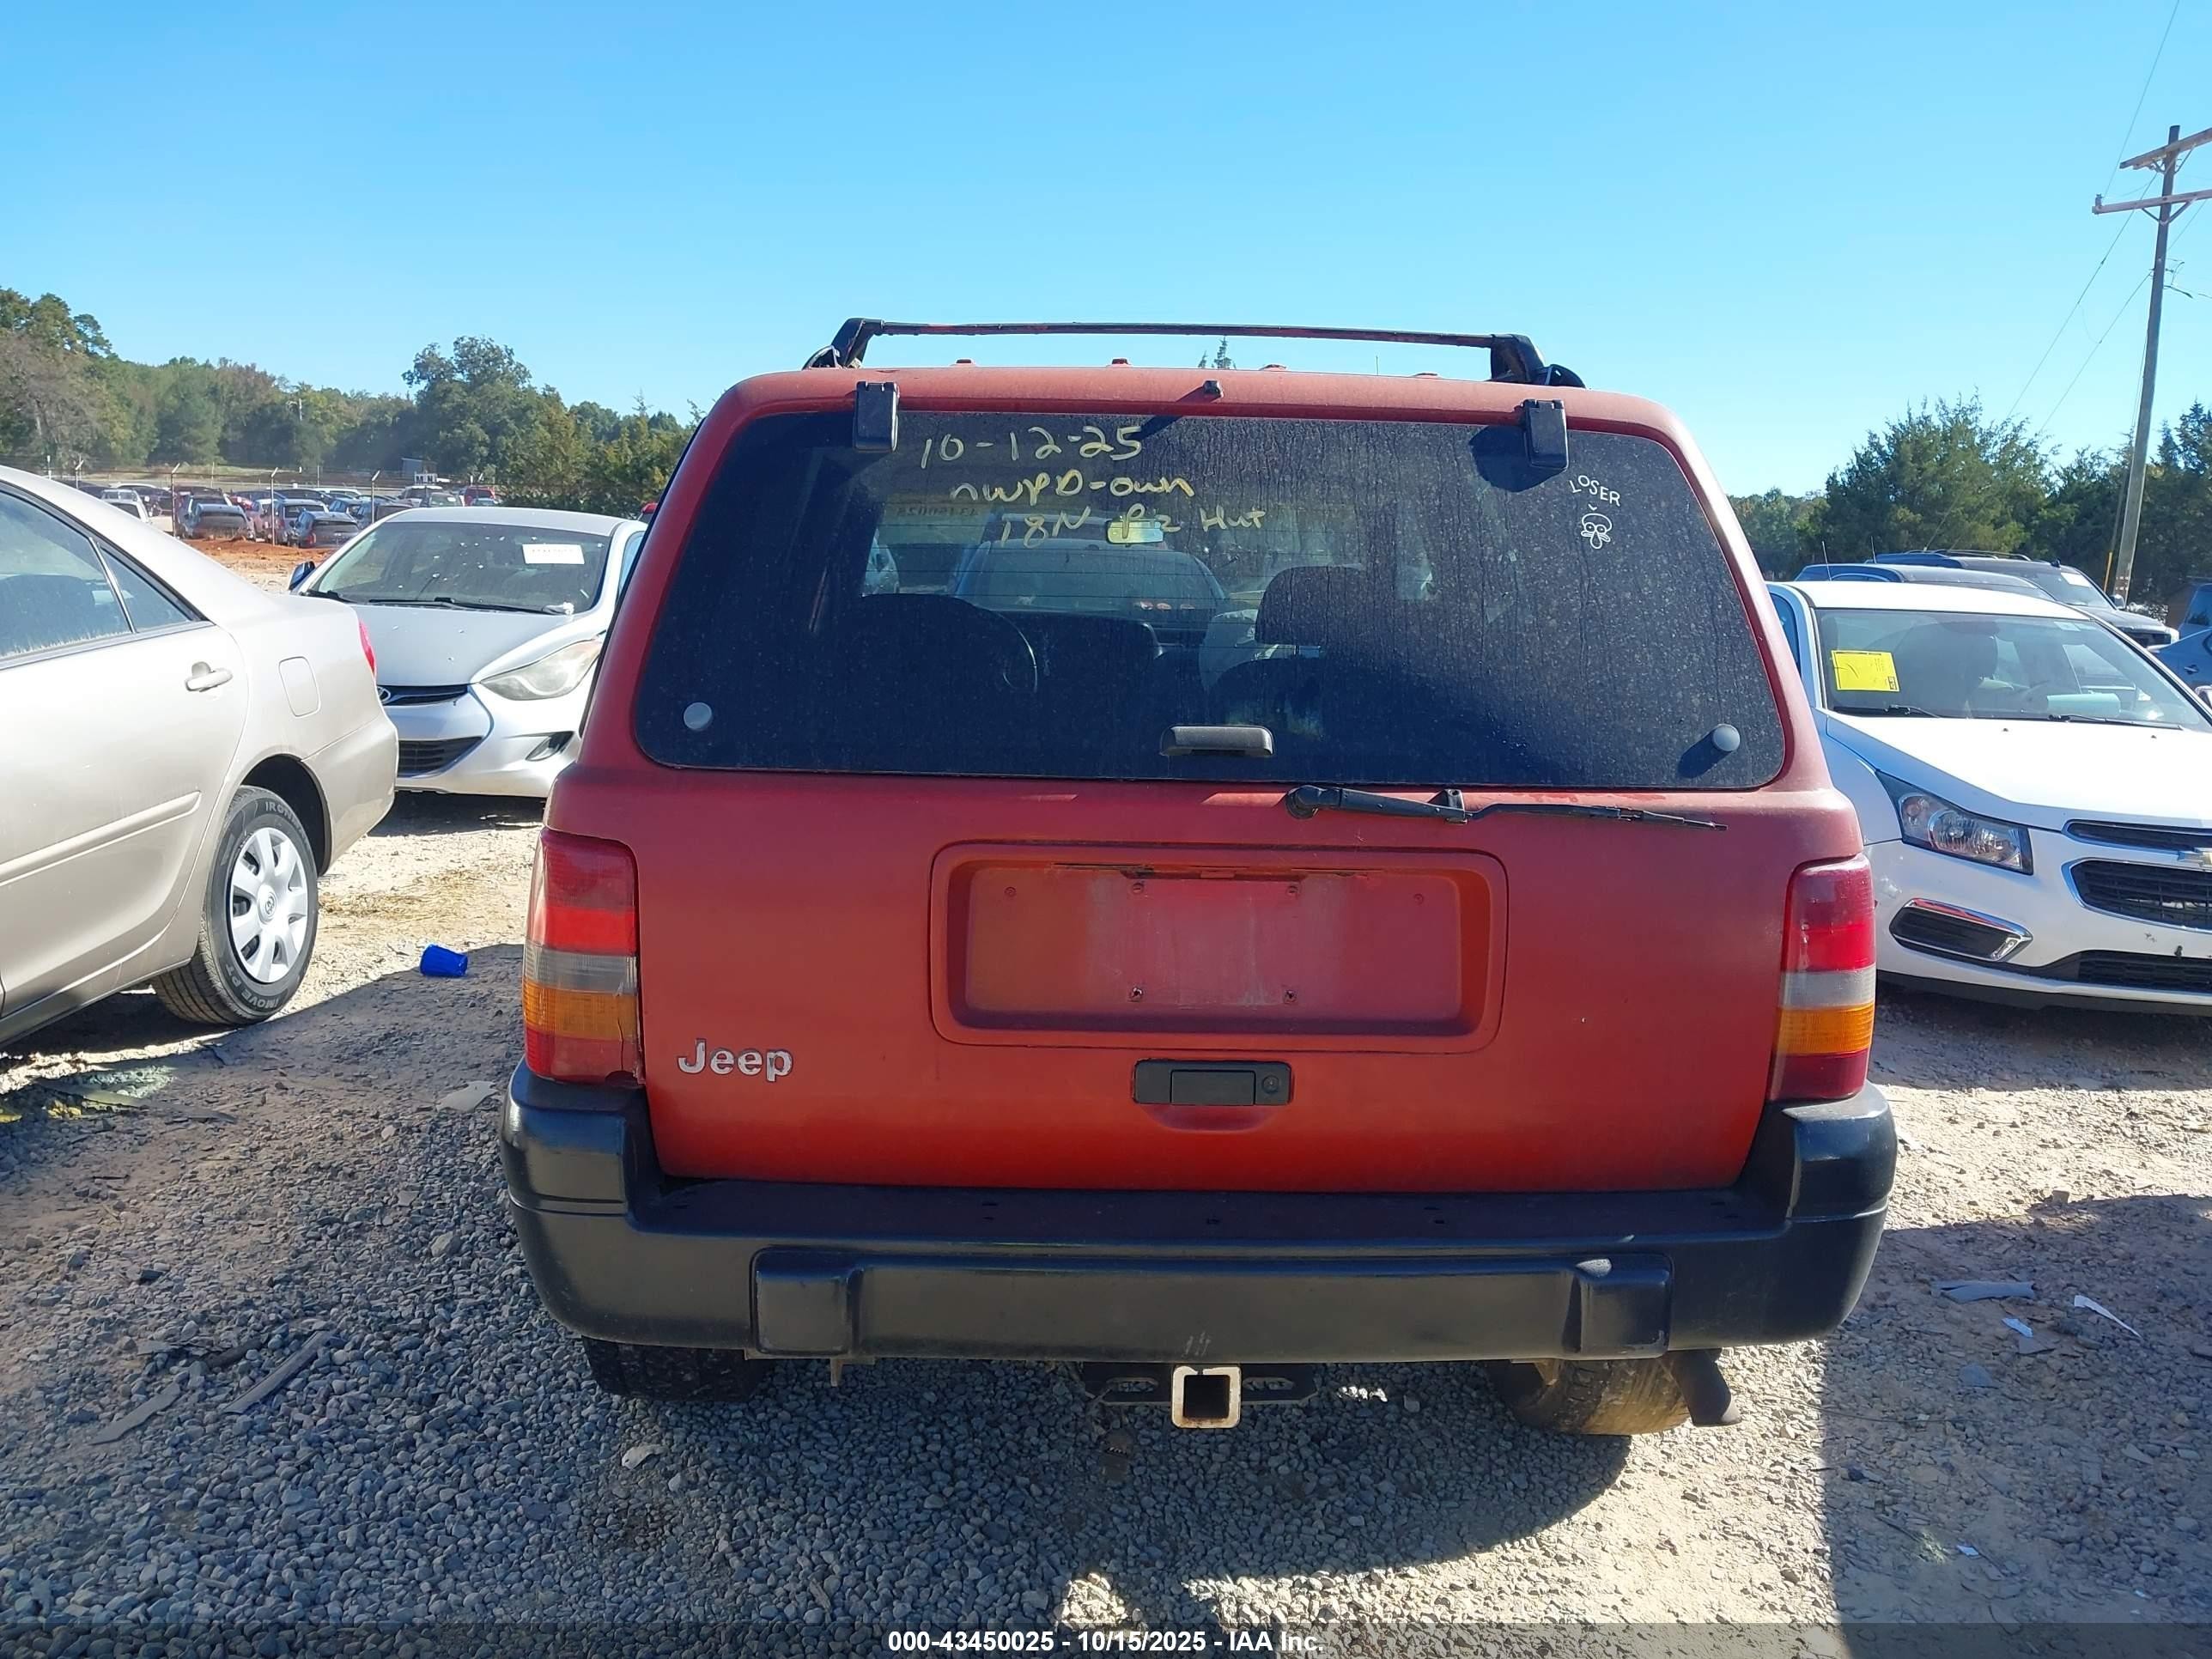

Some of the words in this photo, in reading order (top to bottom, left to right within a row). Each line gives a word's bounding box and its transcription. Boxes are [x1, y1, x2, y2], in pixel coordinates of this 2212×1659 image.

[921, 426, 1142, 469] 10-12-25
[1569, 475, 1621, 507] LOSER
[1200, 504, 1266, 532] Hut
[678, 1038, 793, 1082] Jeep
